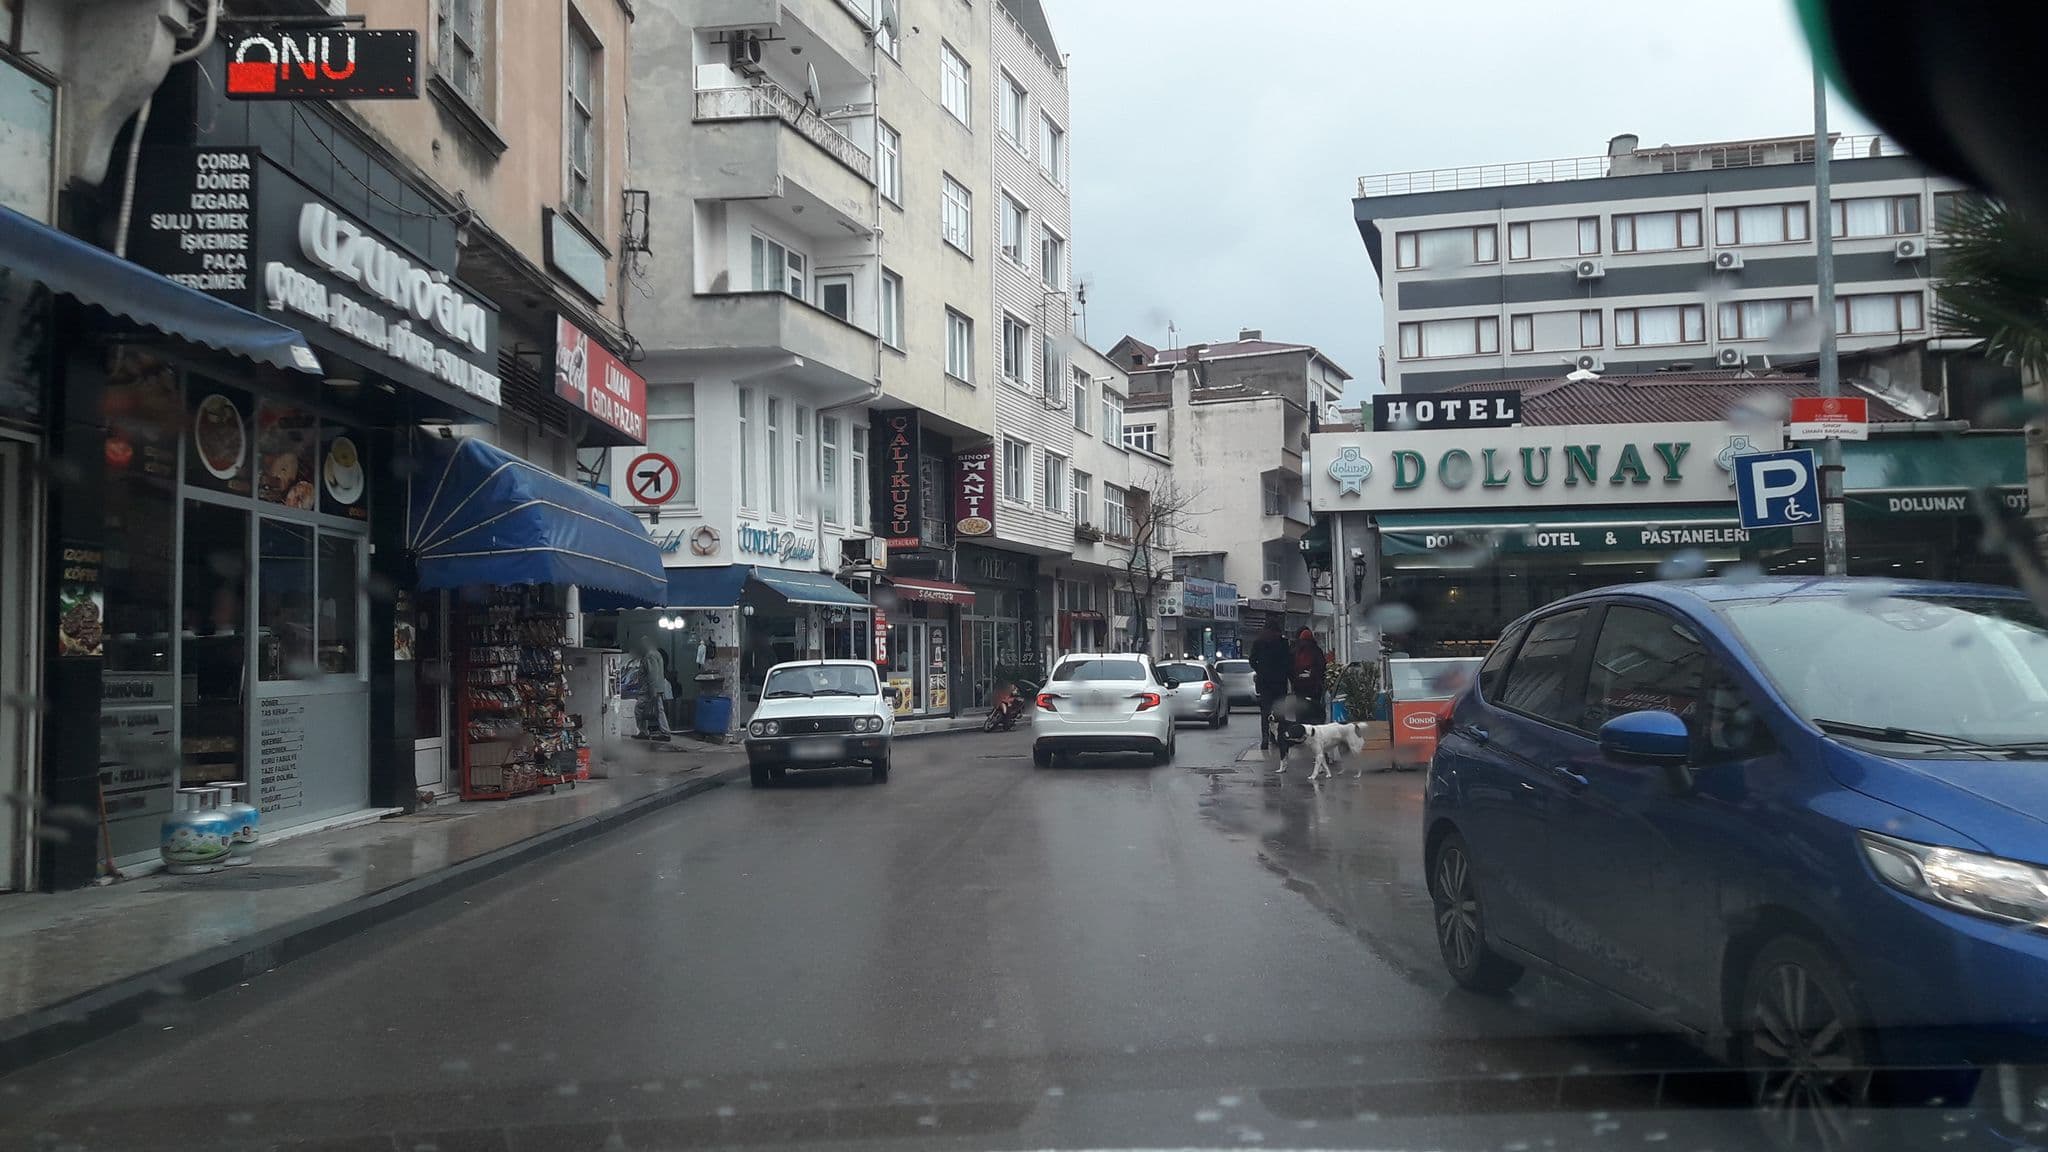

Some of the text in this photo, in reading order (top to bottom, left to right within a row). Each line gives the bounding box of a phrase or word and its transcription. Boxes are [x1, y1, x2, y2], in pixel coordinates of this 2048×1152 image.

[197, 153, 251, 173] ÇORBA
[196, 169, 250, 189] DÖNER
[191, 193, 250, 209] IZGARA
[150, 213, 249, 230] SULU YEMEK
[181, 230, 248, 254] İŞKEMBE
[203, 253, 248, 273] PAÇA
[604, 361, 631, 402] LİMAN
[1387, 398, 1515, 423] HOTEL
[1391, 442, 1691, 490] DOLUNAY
[962, 461, 986, 516] MANTI
[1752, 459, 1807, 519] P
[1889, 496, 1966, 512] DOLUNAY
[1605, 532, 1617, 545] &
[1641, 527, 1750, 545] PASTANELERİ
[875, 636, 887, 661] 15
